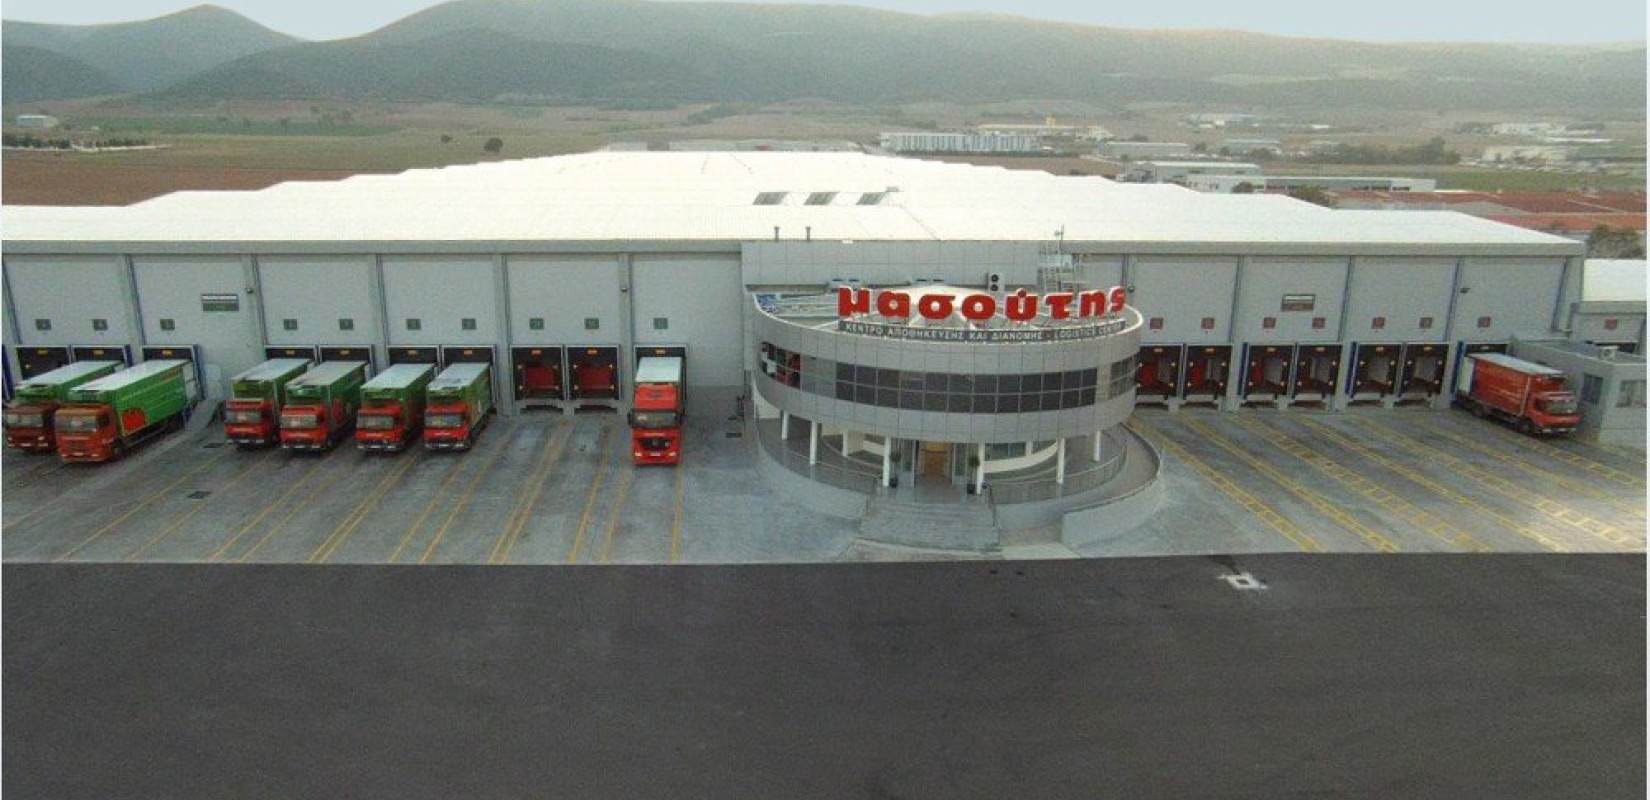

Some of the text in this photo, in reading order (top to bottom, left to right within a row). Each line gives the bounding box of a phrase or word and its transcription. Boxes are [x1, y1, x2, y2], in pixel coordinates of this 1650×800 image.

[837, 286, 1126, 321] μασούτης
[846, 322, 883, 335] ΚΕΝΤΡΟ
[888, 328, 964, 340] ΑΠΟΘΗΚΕΥΣΗΣ
[969, 331, 988, 340] ΚΑΙ
[991, 330, 1043, 340] ΔΙΑΝΟΜΗΣ
